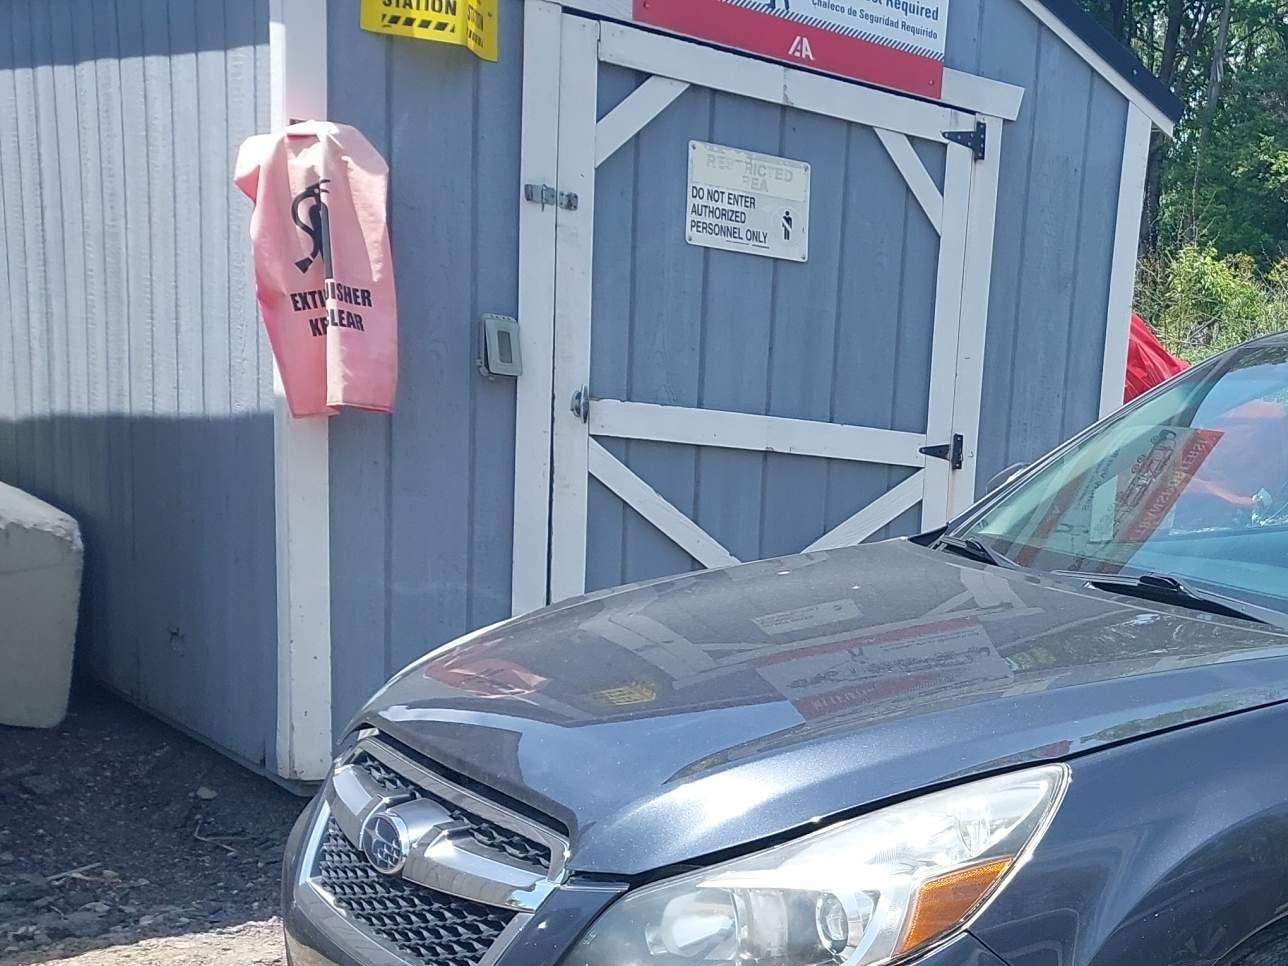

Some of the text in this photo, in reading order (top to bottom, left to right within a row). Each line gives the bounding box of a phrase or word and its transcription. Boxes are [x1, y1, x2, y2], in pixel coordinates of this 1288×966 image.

[812, 0, 845, 13] Chaleco
[847, 6, 857, 17] de
[859, 9, 899, 29] Seguridad
[691, 186, 756, 209] DO NOT ENTER
[691, 203, 746, 224] AUTHORIZED
[690, 220, 768, 244] PERSONNEL ONLY
